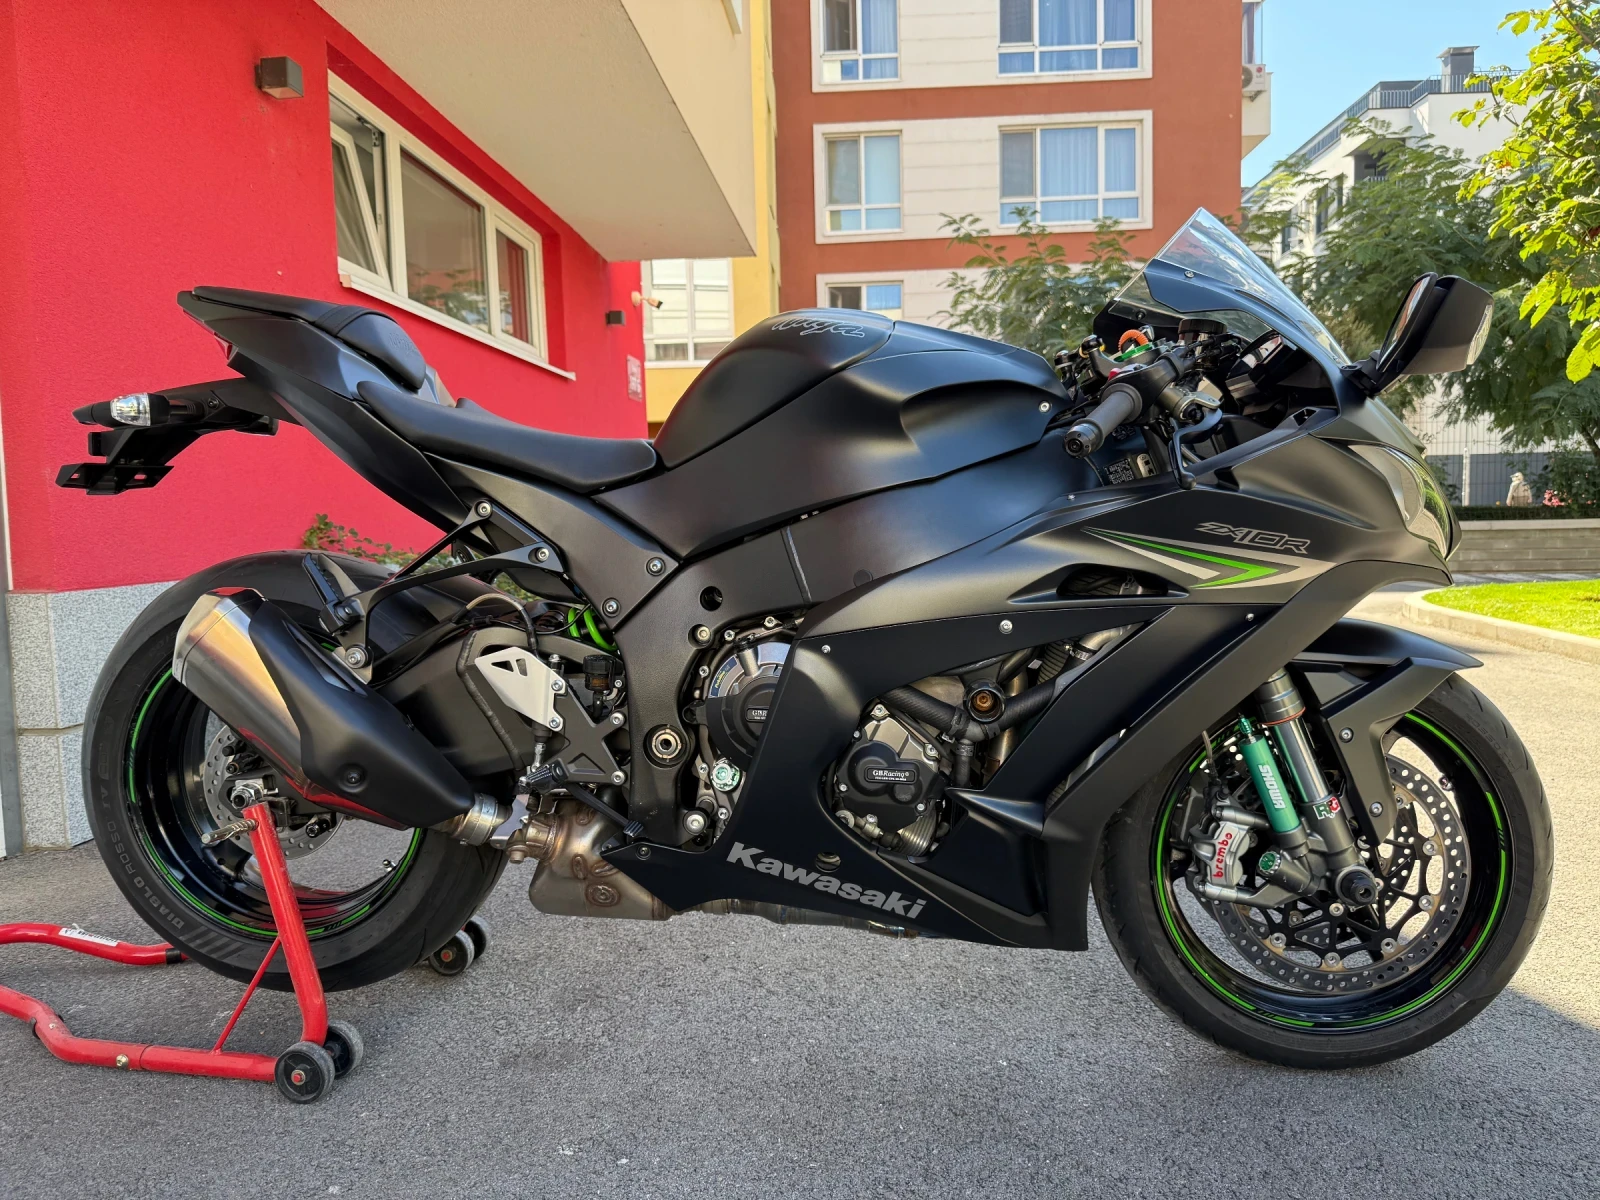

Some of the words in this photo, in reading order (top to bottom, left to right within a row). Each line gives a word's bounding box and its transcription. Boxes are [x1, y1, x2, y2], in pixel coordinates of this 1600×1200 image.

[1258, 764, 1286, 809] SHOWA
[107, 821, 136, 875] ROSSO
[1212, 832, 1233, 879] brembo
[133, 875, 185, 930] DIABLO
[726, 841, 927, 919] Kawasaki
